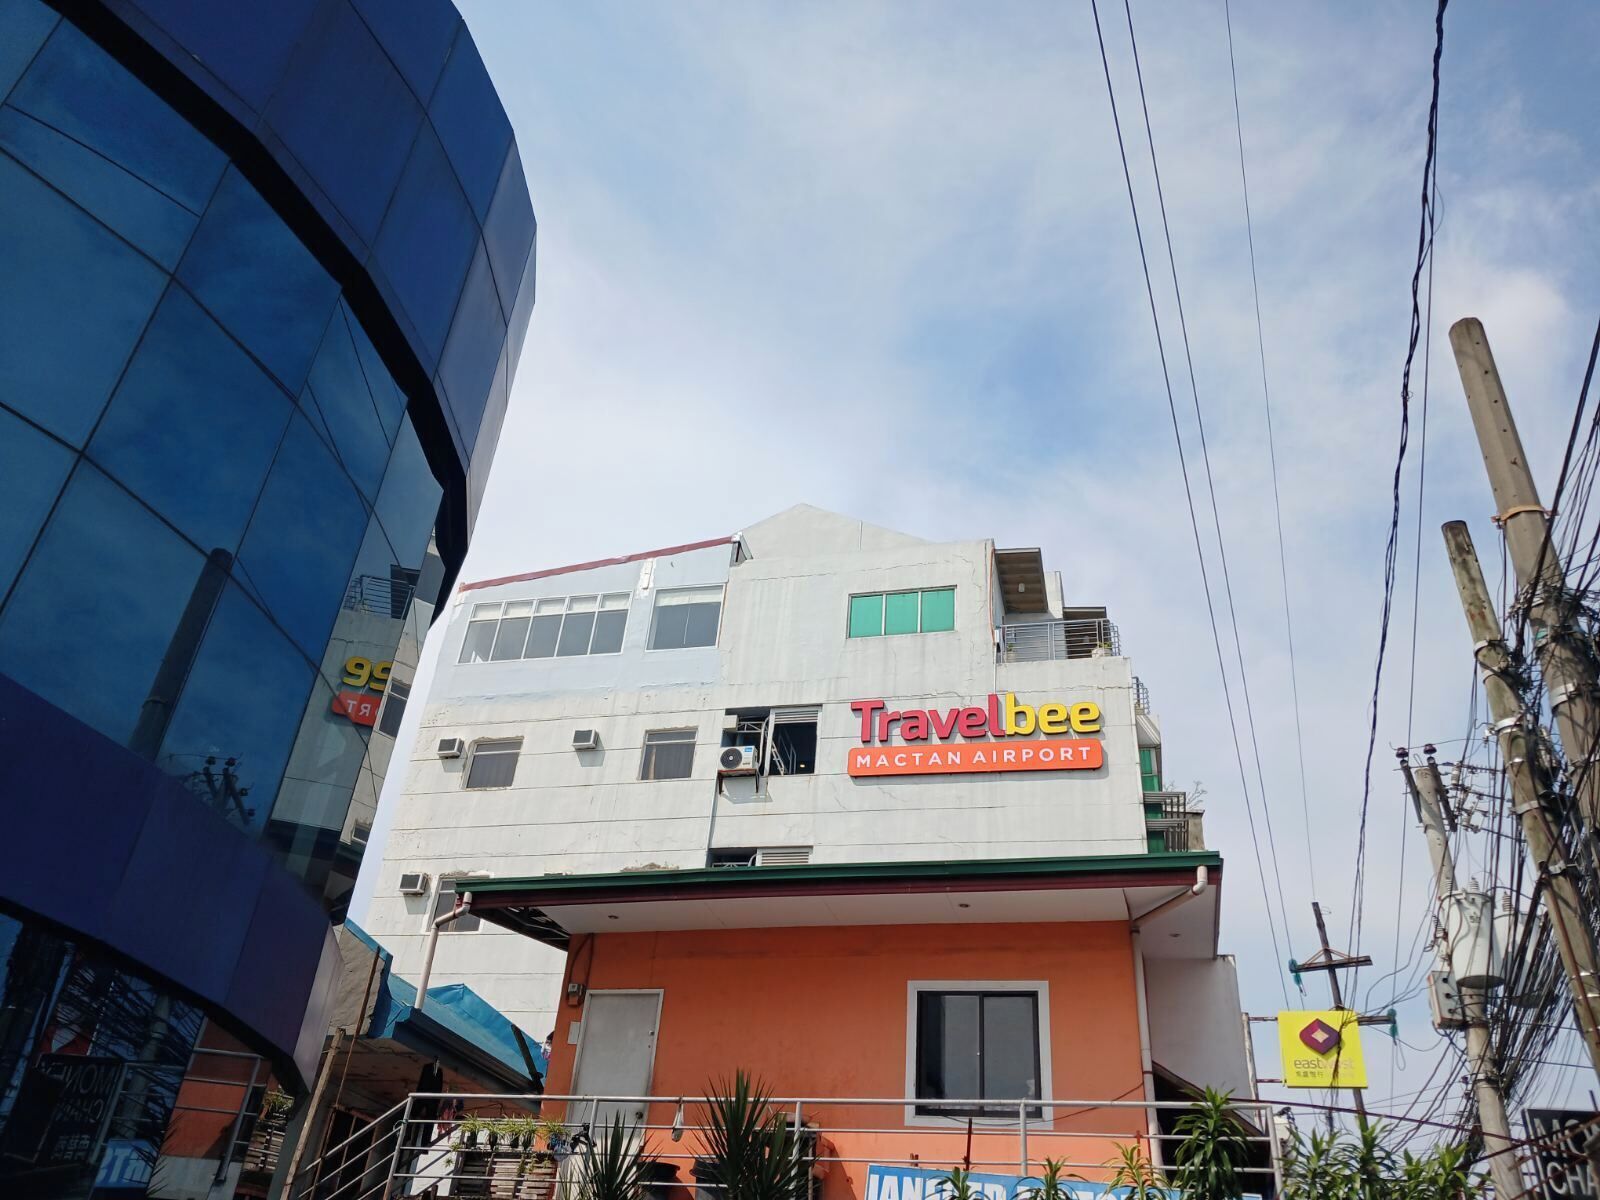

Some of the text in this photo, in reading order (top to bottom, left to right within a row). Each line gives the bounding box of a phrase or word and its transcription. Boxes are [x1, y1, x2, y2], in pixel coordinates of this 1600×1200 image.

[851, 692, 1101, 742] Travelbee
[856, 746, 1091, 768] MACTAN AIRPORT
[1293, 1057, 1355, 1070] eastwst
